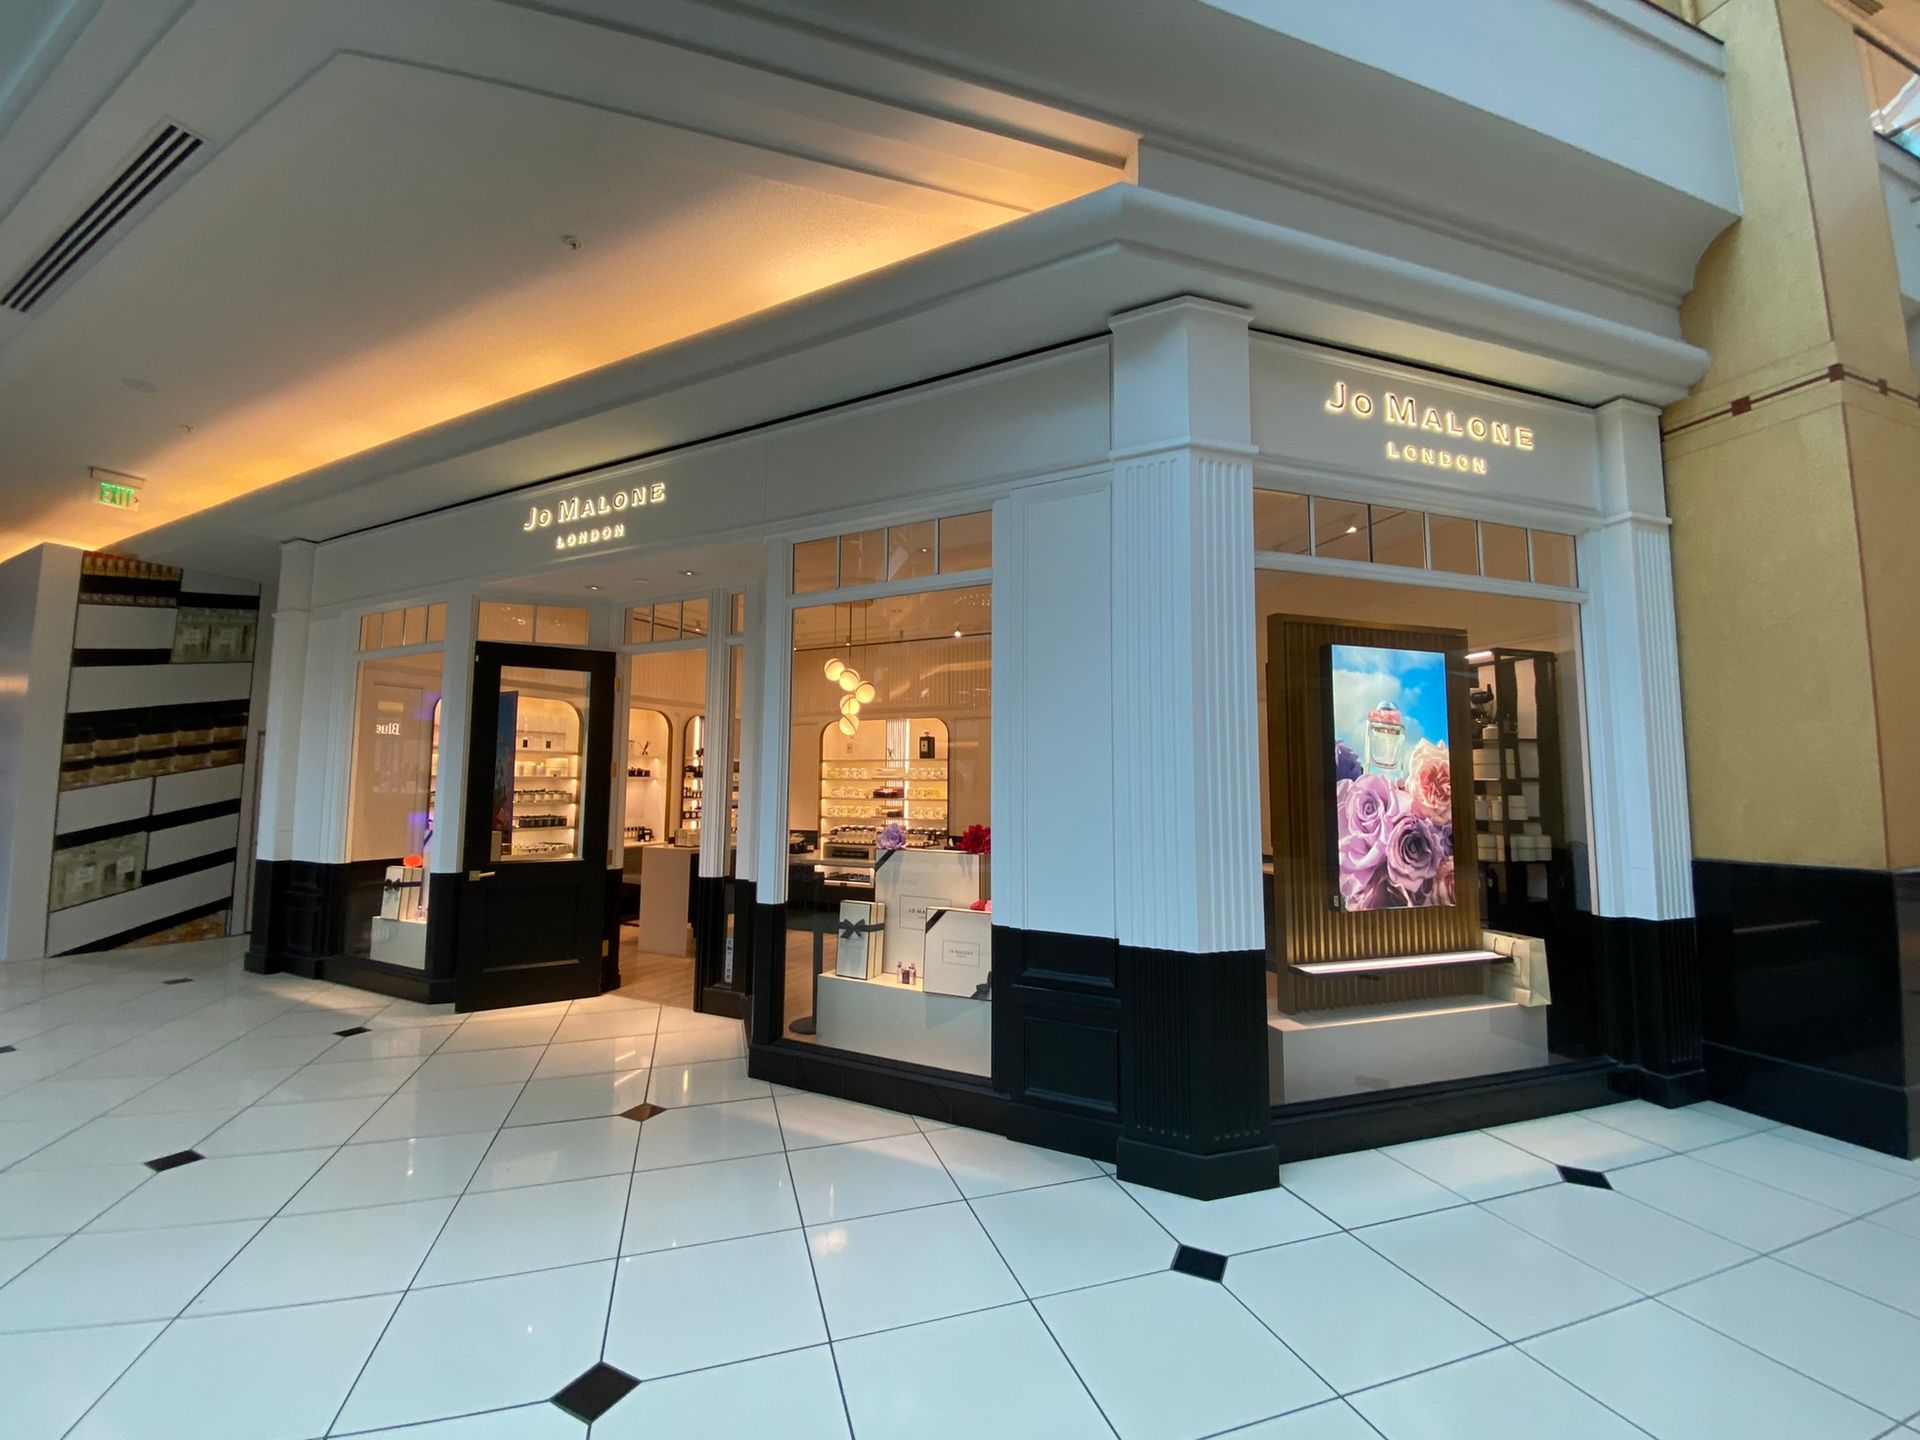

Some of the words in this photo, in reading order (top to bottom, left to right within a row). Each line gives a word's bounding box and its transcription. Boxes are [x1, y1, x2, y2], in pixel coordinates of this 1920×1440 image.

[1384, 392, 1535, 450] MALONE
[1386, 441, 1488, 475] LONDON
[100, 483, 134, 508] EXIT
[557, 482, 667, 523] MALONE
[556, 523, 626, 549] LONDON
